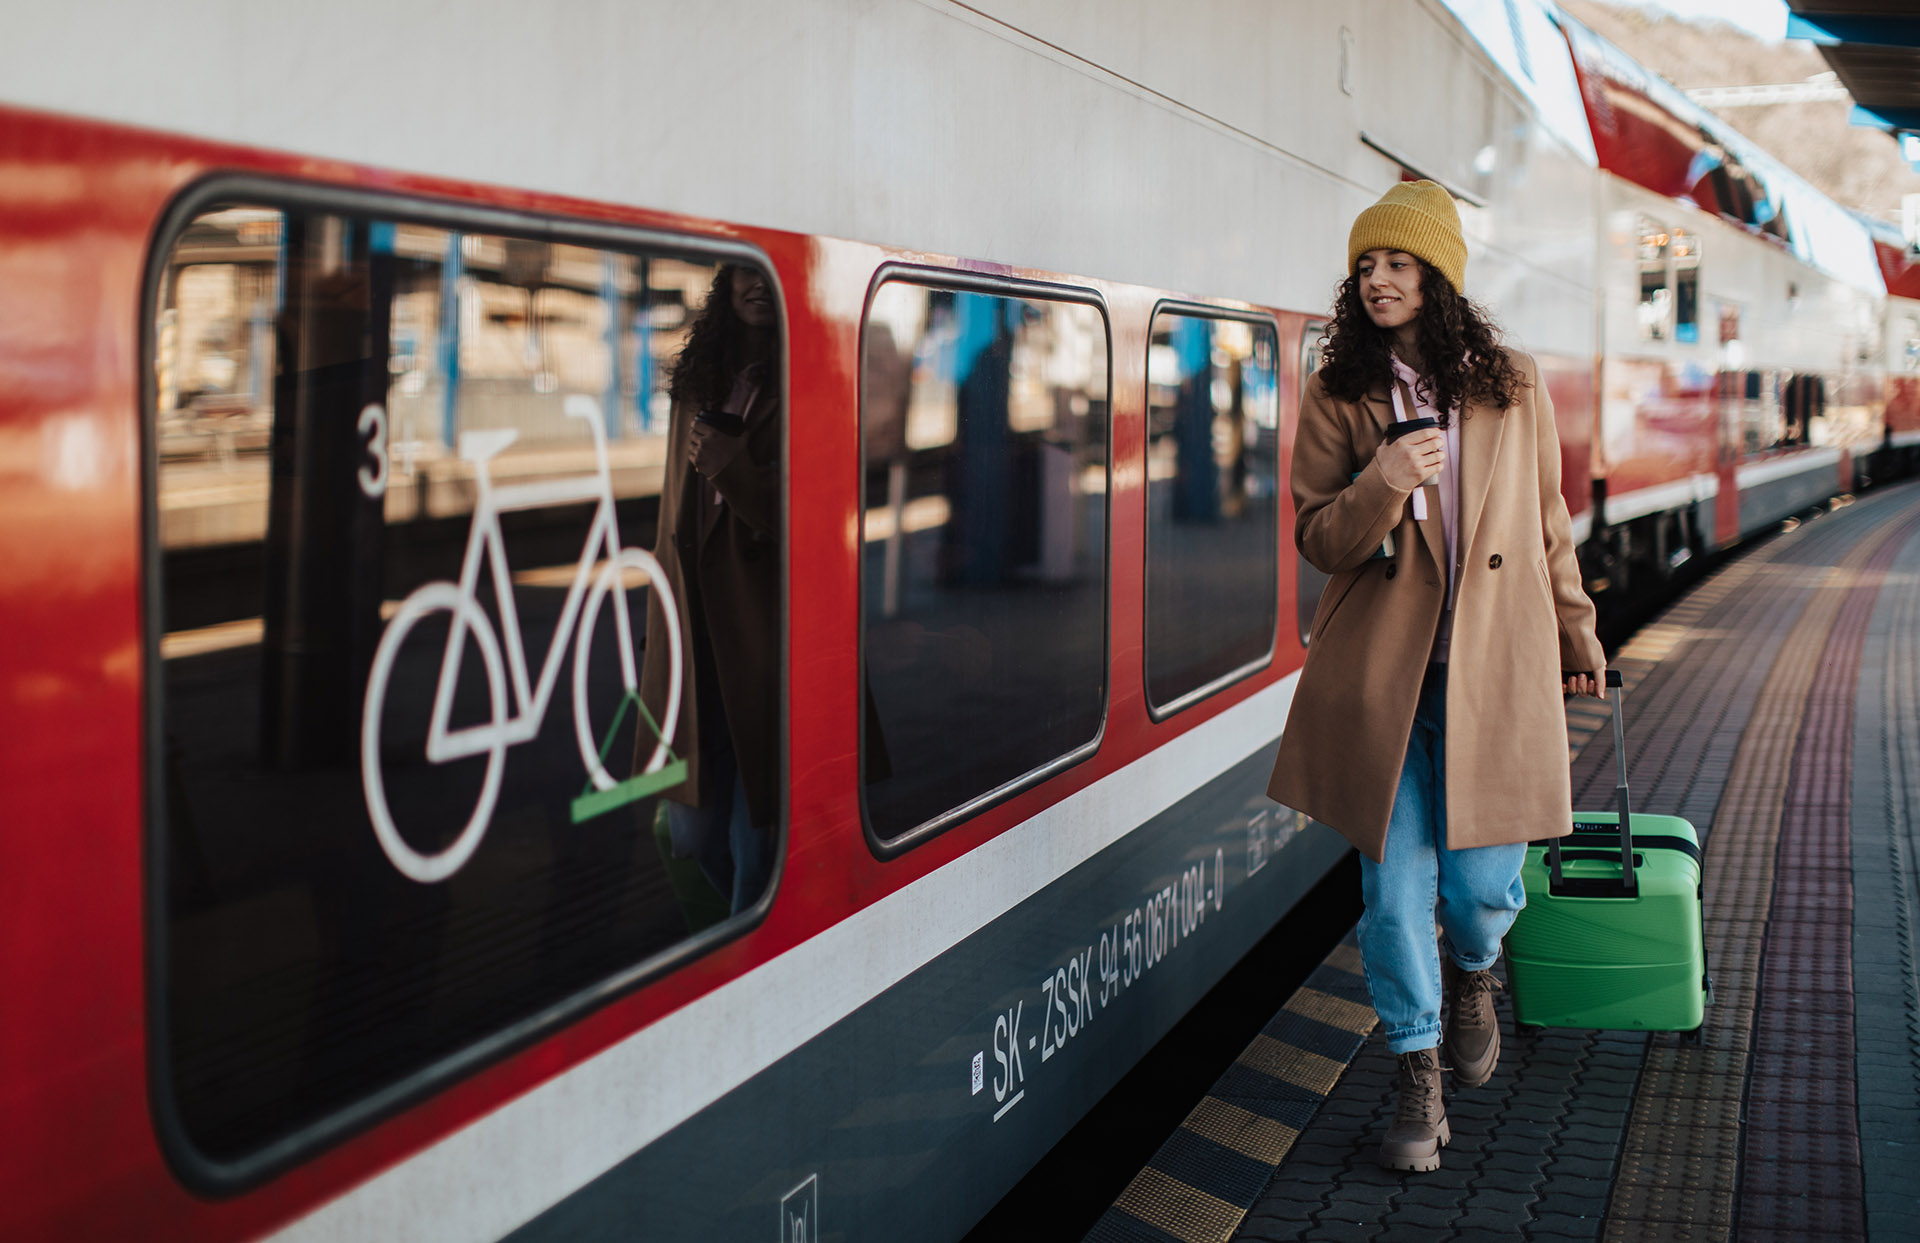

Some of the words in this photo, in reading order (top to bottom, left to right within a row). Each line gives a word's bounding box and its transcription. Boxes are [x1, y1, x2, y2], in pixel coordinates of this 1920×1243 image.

[357, 402, 388, 498] 3
[993, 999, 1025, 1102] SK
[1042, 945, 1093, 1063] ZSSK
[1099, 923, 1119, 1008] 94
[1123, 907, 1142, 988] 56
[1145, 881, 1178, 969] 0671
